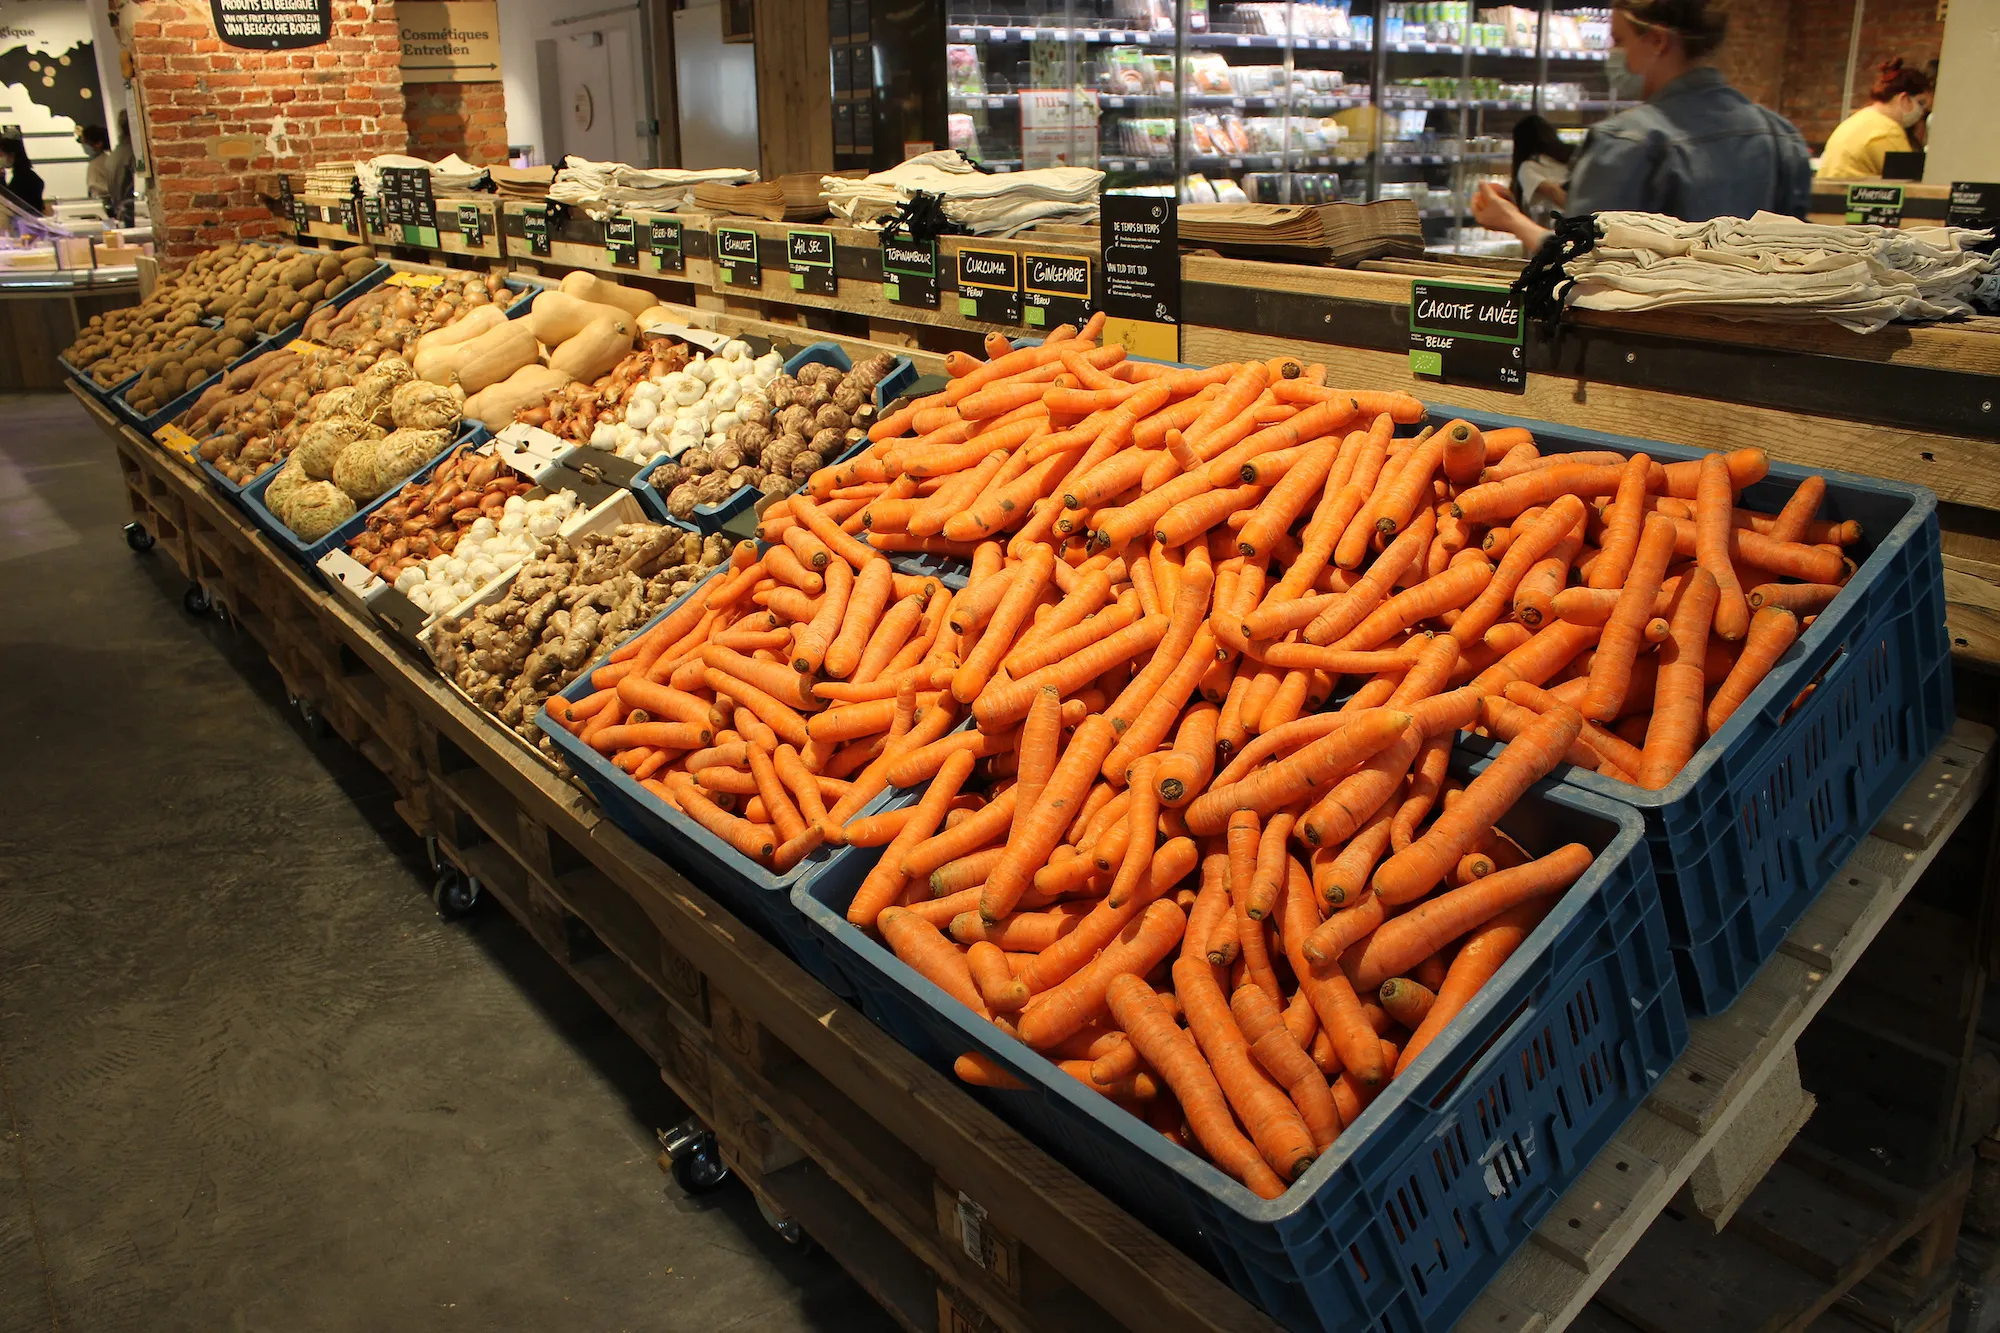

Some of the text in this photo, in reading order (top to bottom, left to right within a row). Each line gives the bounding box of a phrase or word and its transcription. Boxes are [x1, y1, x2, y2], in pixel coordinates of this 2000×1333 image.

[223, 14, 236, 23] VAN
[248, 14, 266, 22] FRUIT
[266, 14, 275, 22] EN
[275, 14, 305, 23] GROENTEN
[224, 22, 321, 36] VAN BELGISCHE BODEM!
[401, 28, 489, 43] Cosmétiques
[403, 44, 469, 56] Entretien
[1113, 221, 1121, 232] DE
[1137, 222, 1144, 233] EN
[807, 240, 823, 254] SEC
[966, 256, 1007, 275] CURCUMA
[1106, 262, 1117, 273] VAN
[966, 286, 984, 297] PÉROU
[1417, 298, 1519, 325] CAROTTE LAVÉE
[1424, 335, 1454, 348] BELGE
[1512, 346, 1521, 359] €
